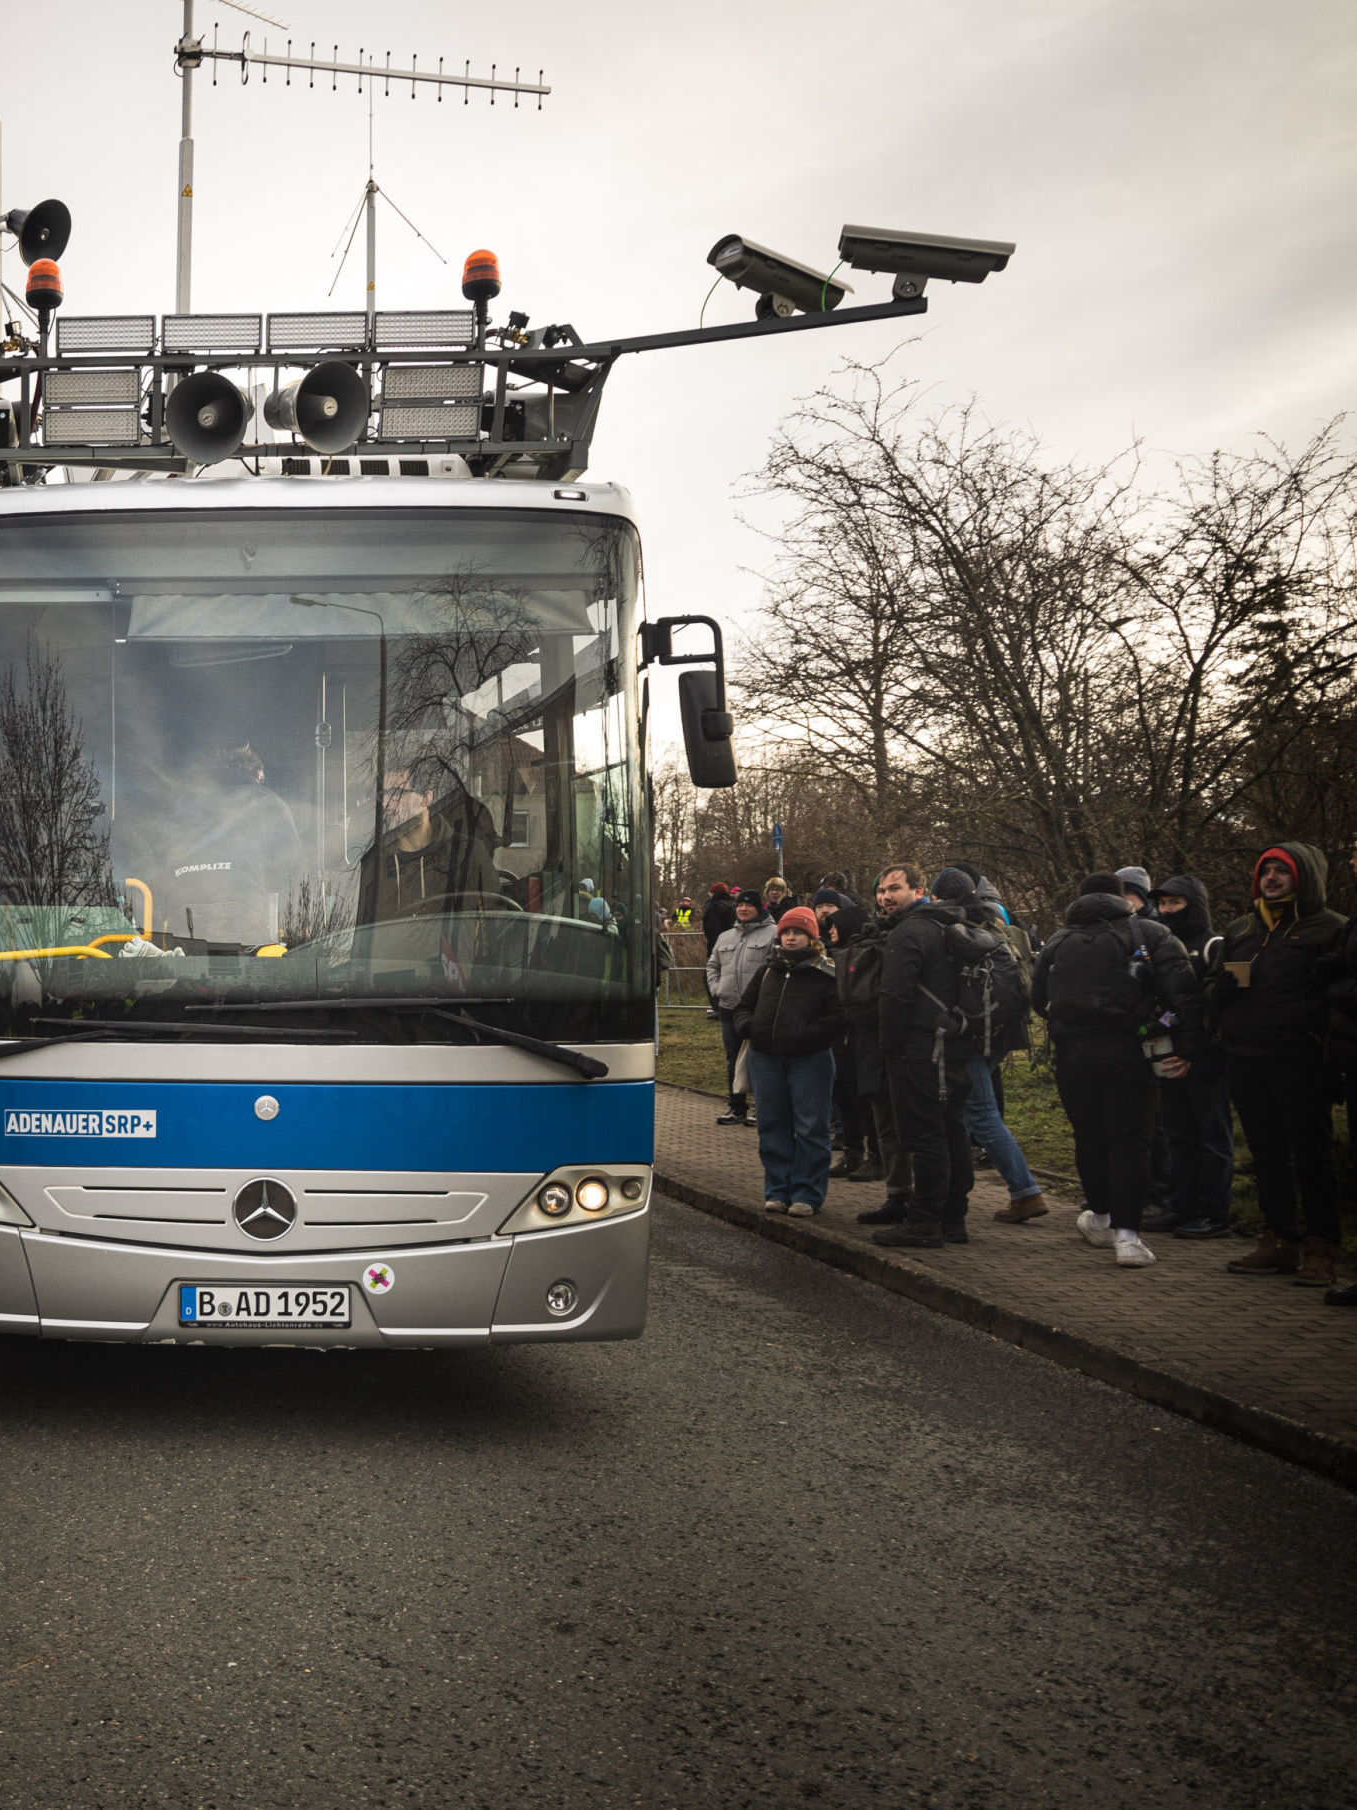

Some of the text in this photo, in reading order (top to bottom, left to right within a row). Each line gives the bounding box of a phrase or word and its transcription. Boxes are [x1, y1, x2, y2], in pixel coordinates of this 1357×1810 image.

[174, 862, 232, 877] KOMPLIZE
[6, 1112, 153, 1134] ADENAUER SRP+
[185, 1291, 345, 1317] D B AD 1952
